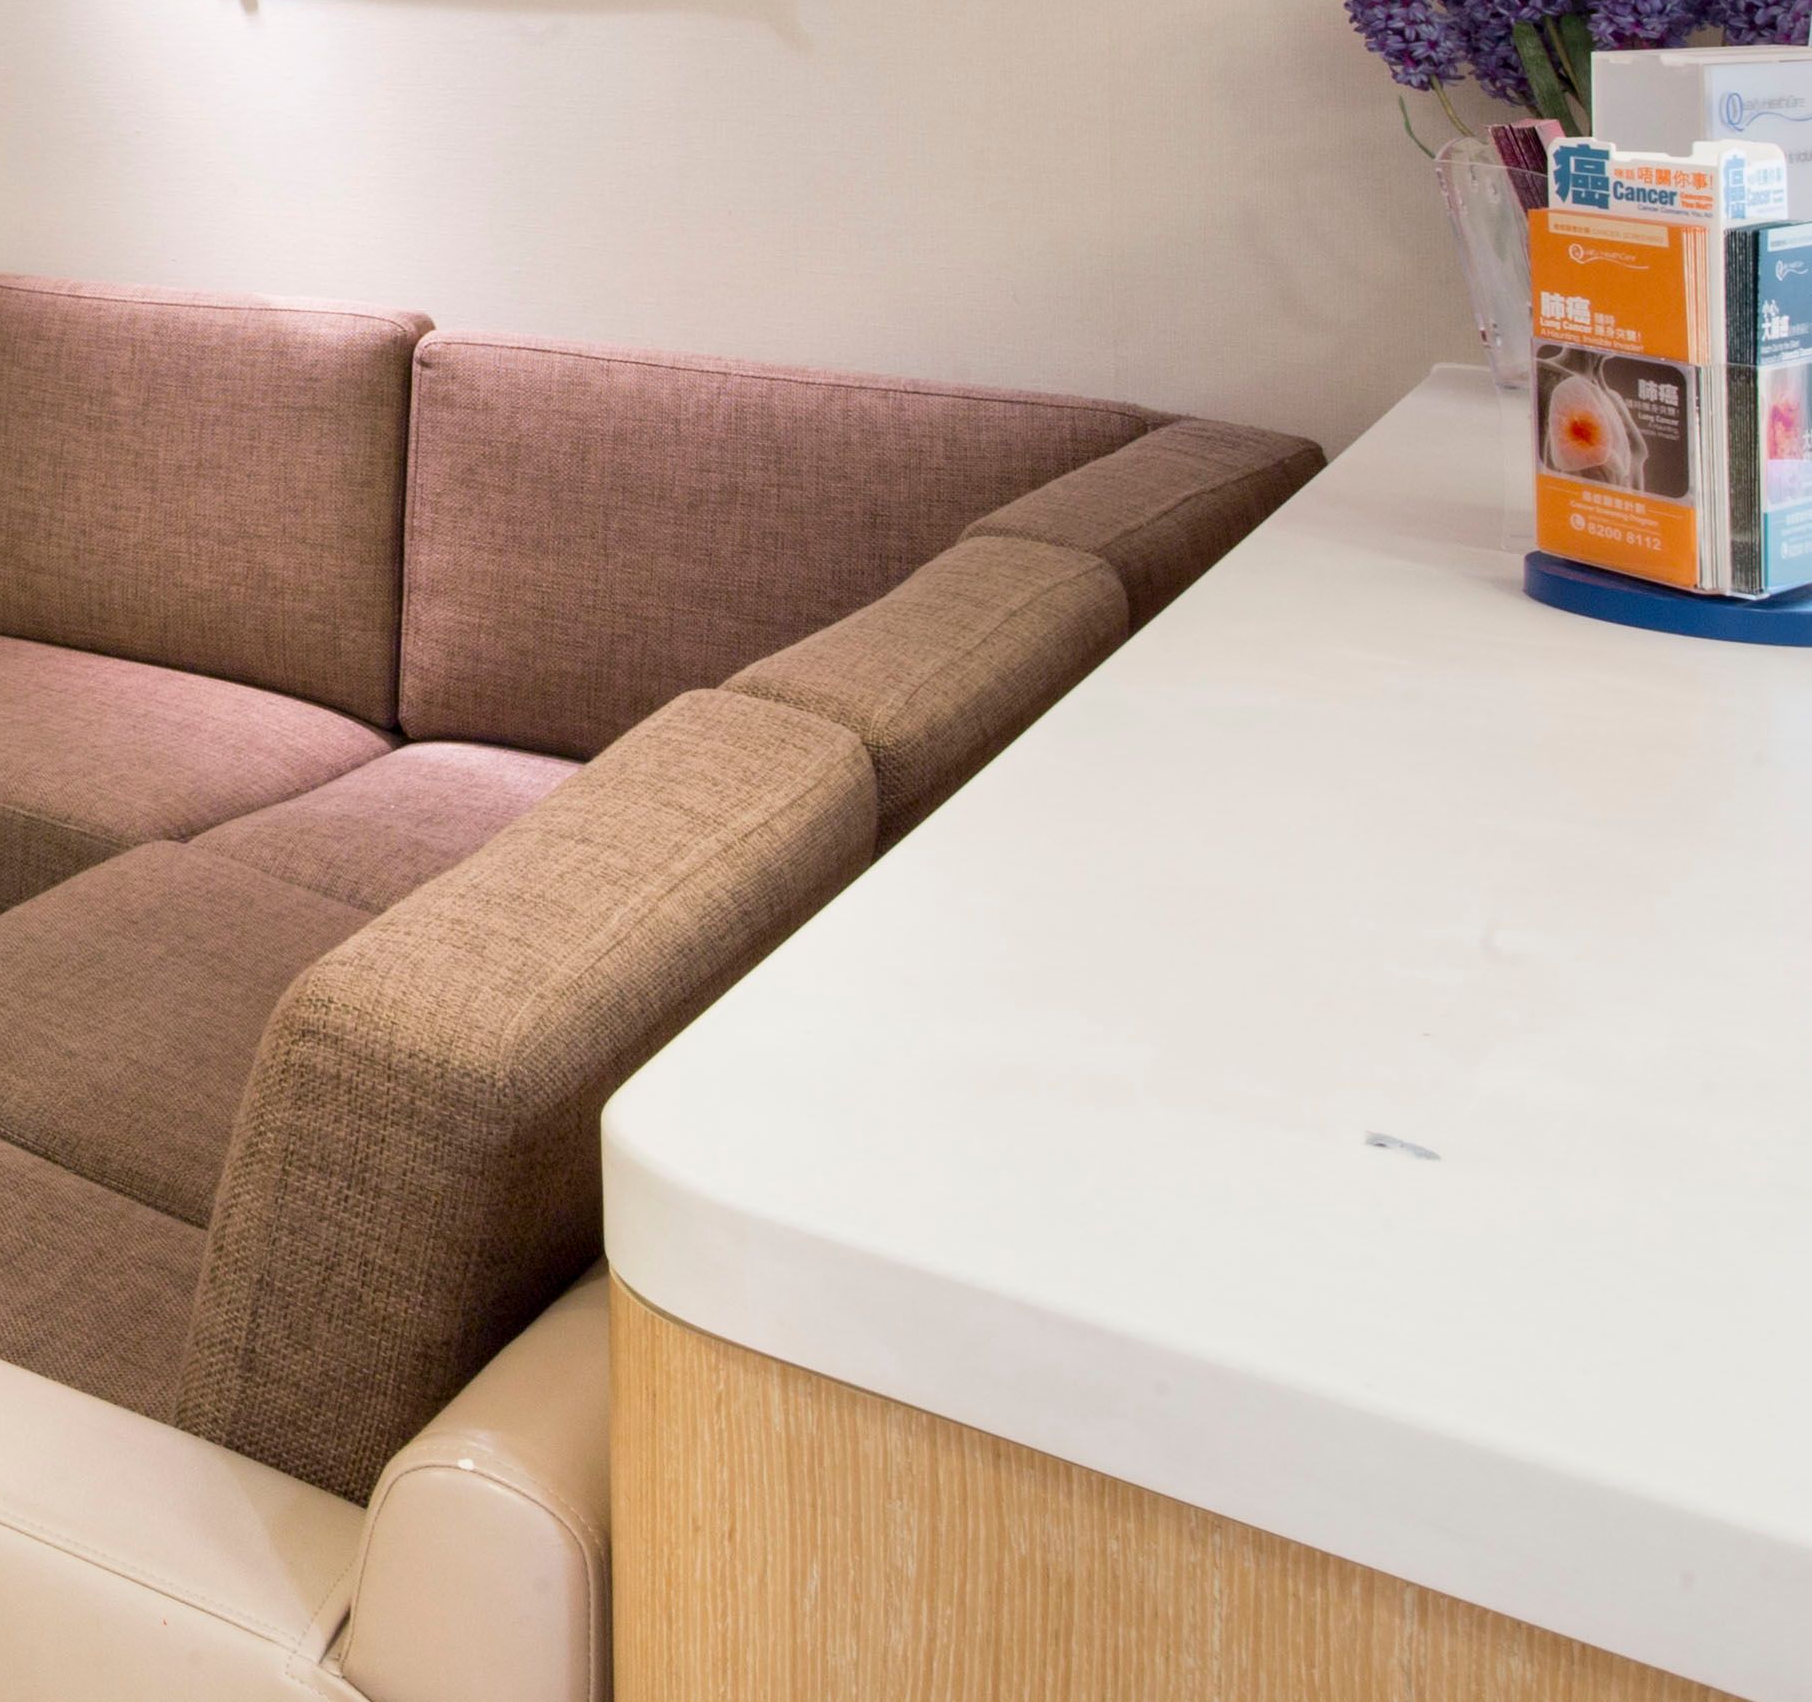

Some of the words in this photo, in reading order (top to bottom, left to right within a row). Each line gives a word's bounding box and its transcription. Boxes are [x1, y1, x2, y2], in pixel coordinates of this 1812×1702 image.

[1553, 143, 1610, 210] 癌
[1613, 180, 1677, 206] Cancer
[1540, 290, 1591, 325] 肺癌
[1540, 316, 1561, 330] Lung
[1562, 320, 1592, 333] Cancer
[1638, 378, 1679, 407] 肺癌
[1638, 412, 1655, 423] Lung
[1655, 415, 1679, 426] Cancer
[1588, 522, 1622, 542] 8200
[1626, 531, 1663, 551] 8112
